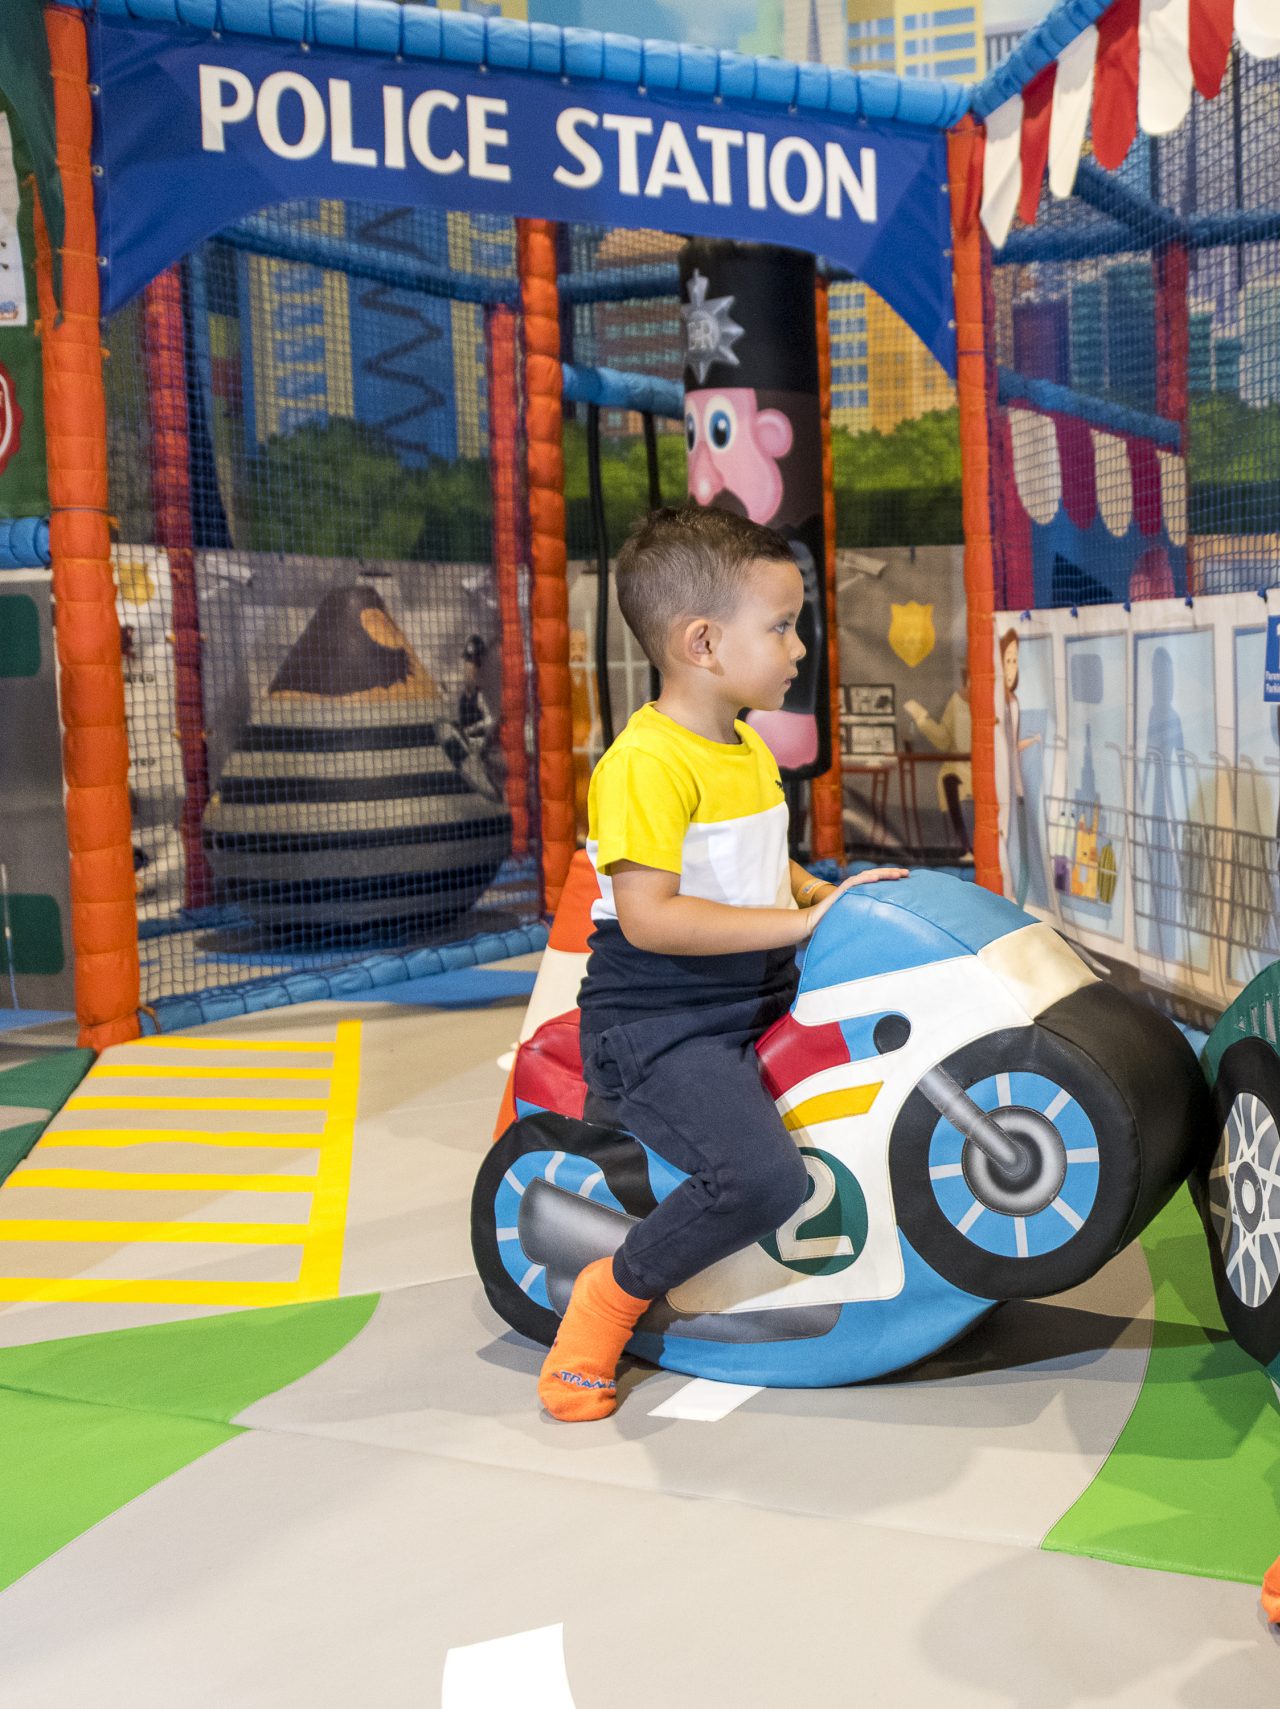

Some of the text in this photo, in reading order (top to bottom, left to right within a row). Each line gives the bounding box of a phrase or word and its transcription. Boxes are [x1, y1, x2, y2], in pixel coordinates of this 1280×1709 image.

[199, 64, 879, 224] POLICE STATION
[776, 1155, 855, 1262] 2
